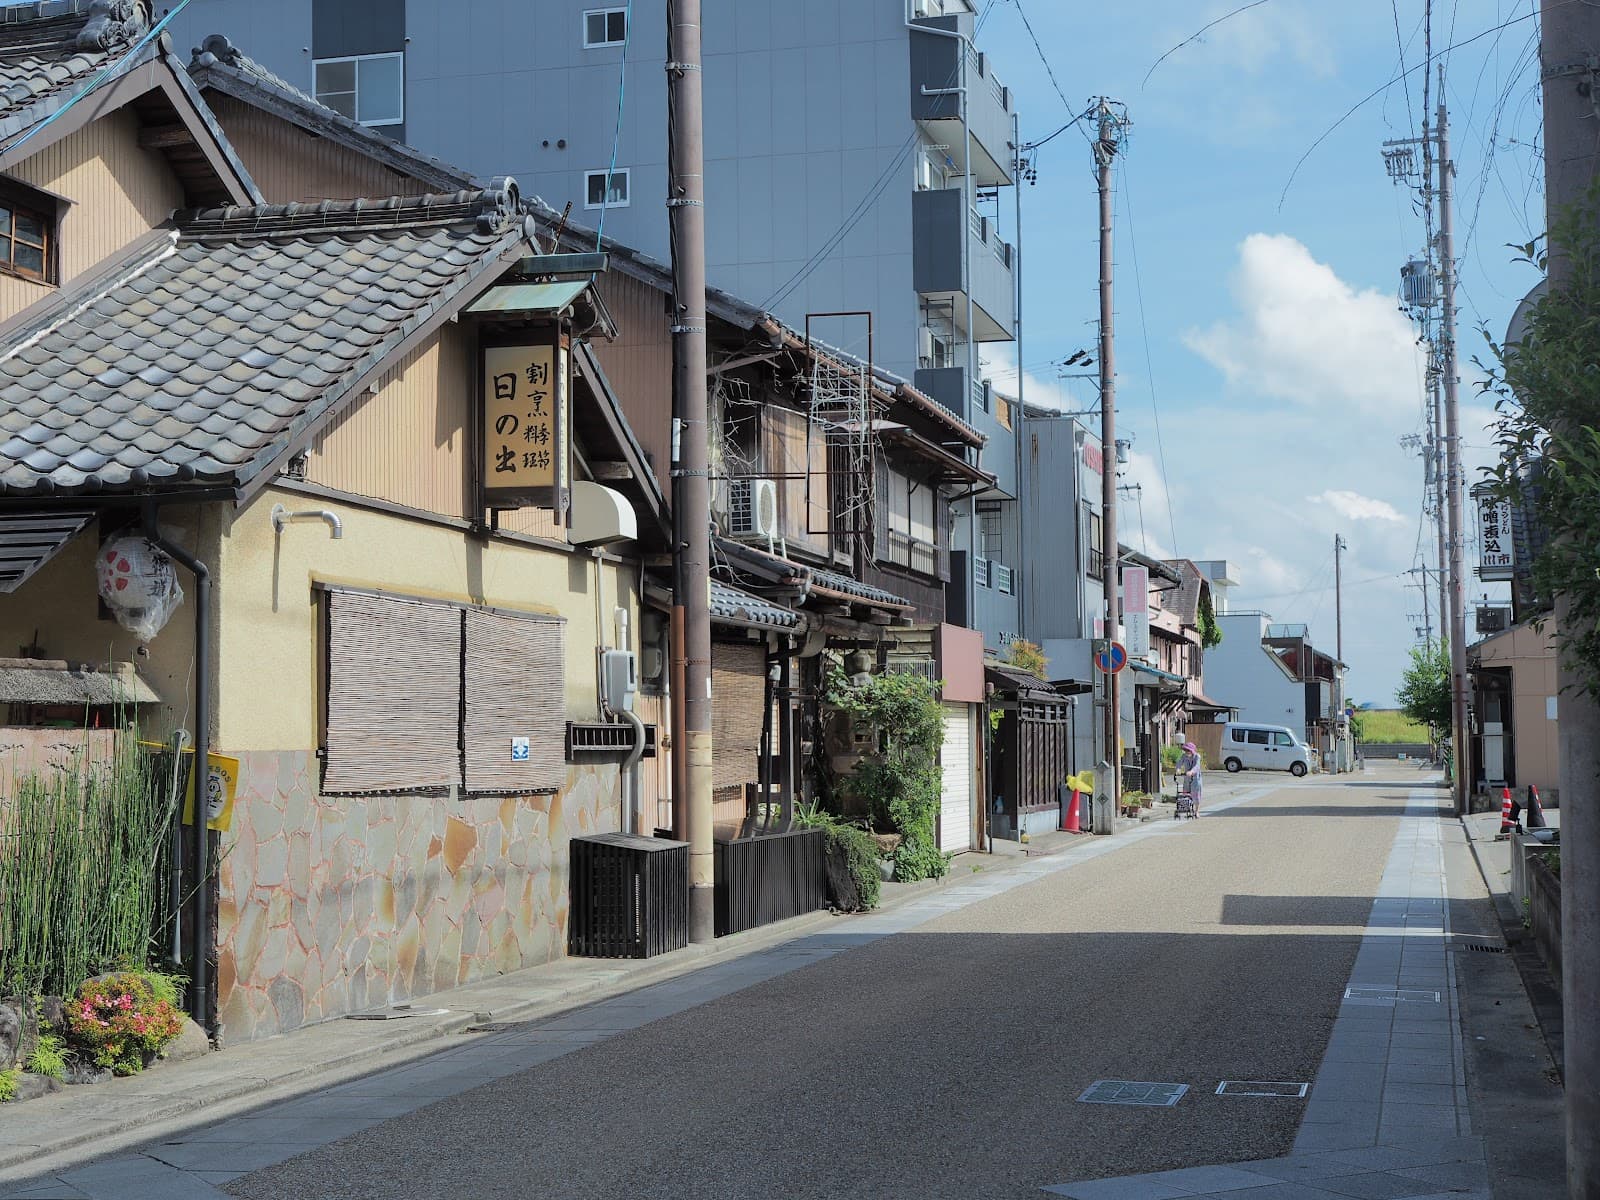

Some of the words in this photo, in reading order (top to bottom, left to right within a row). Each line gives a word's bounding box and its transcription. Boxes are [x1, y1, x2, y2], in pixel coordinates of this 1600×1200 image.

[493, 372, 519, 473] 日の出
[525, 362, 548, 417] 割烹
